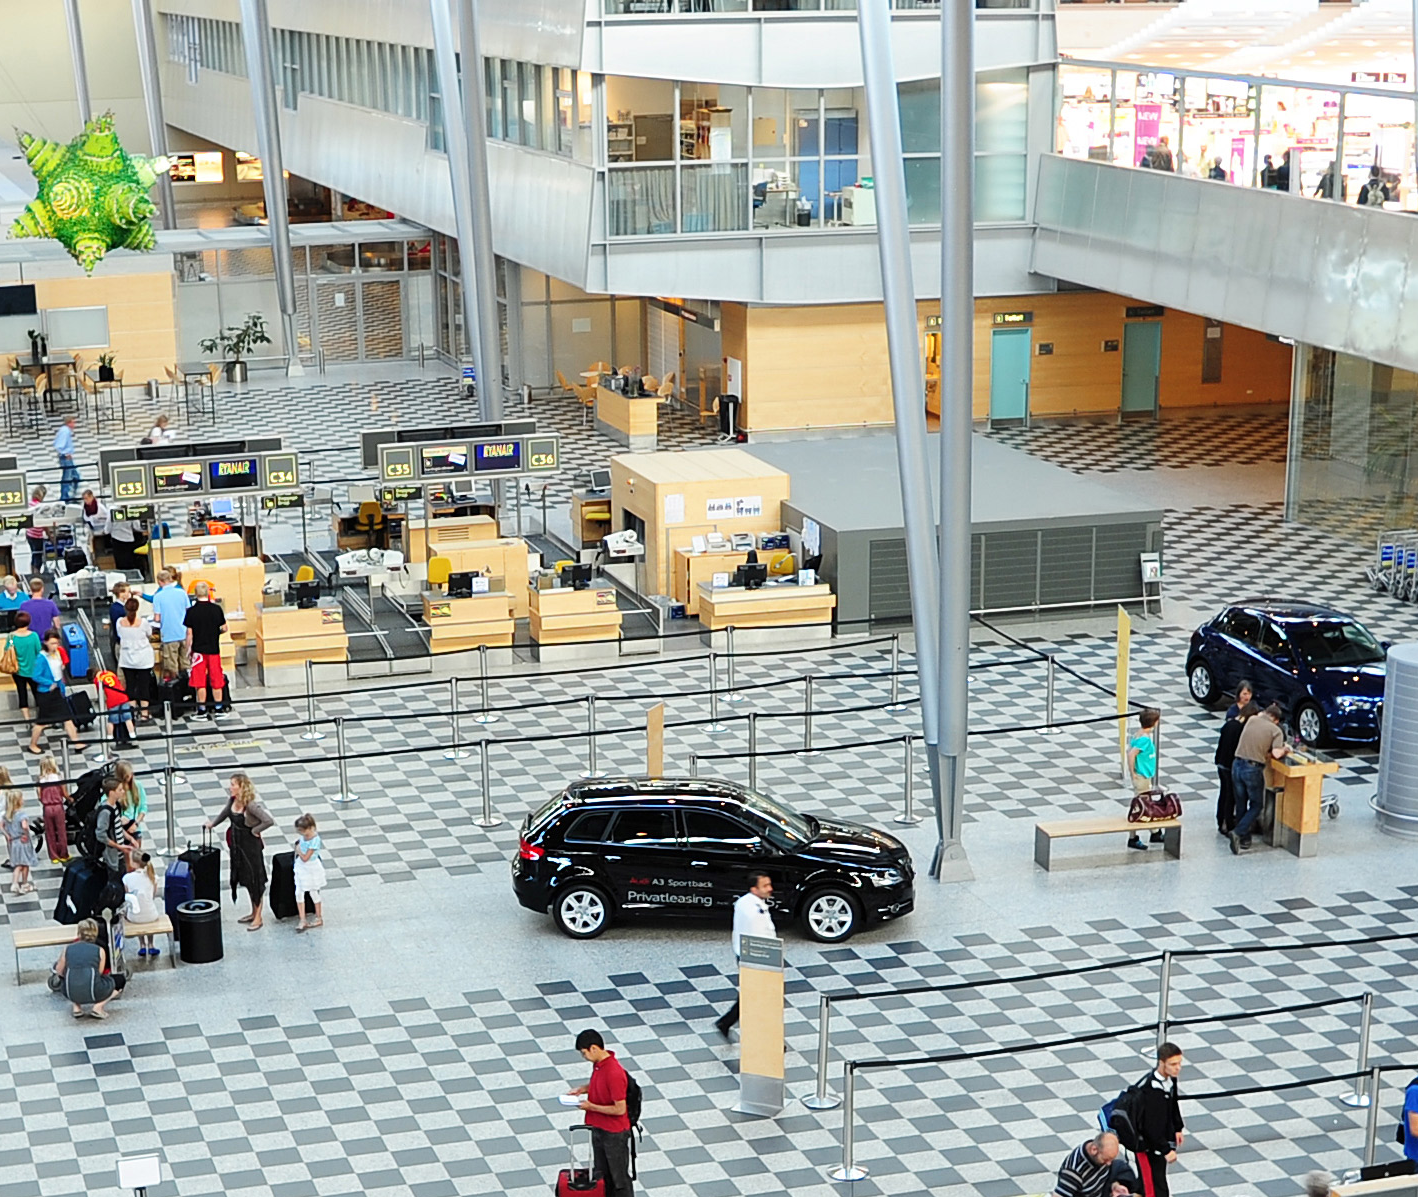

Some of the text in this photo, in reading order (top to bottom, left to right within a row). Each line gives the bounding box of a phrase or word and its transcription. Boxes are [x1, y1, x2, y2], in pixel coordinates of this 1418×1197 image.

[483, 443, 514, 458] RYANAIR
[531, 453, 555, 466] C36
[218, 460, 250, 476] RYANAIR
[387, 463, 411, 476] C35
[269, 470, 294, 484] C34
[118, 482, 143, 496] C33
[105, 675, 115, 687] 9
[652, 878, 665, 886] A3
[667, 878, 714, 888] Sportback
[627, 891, 713, 907] Privatleasing
